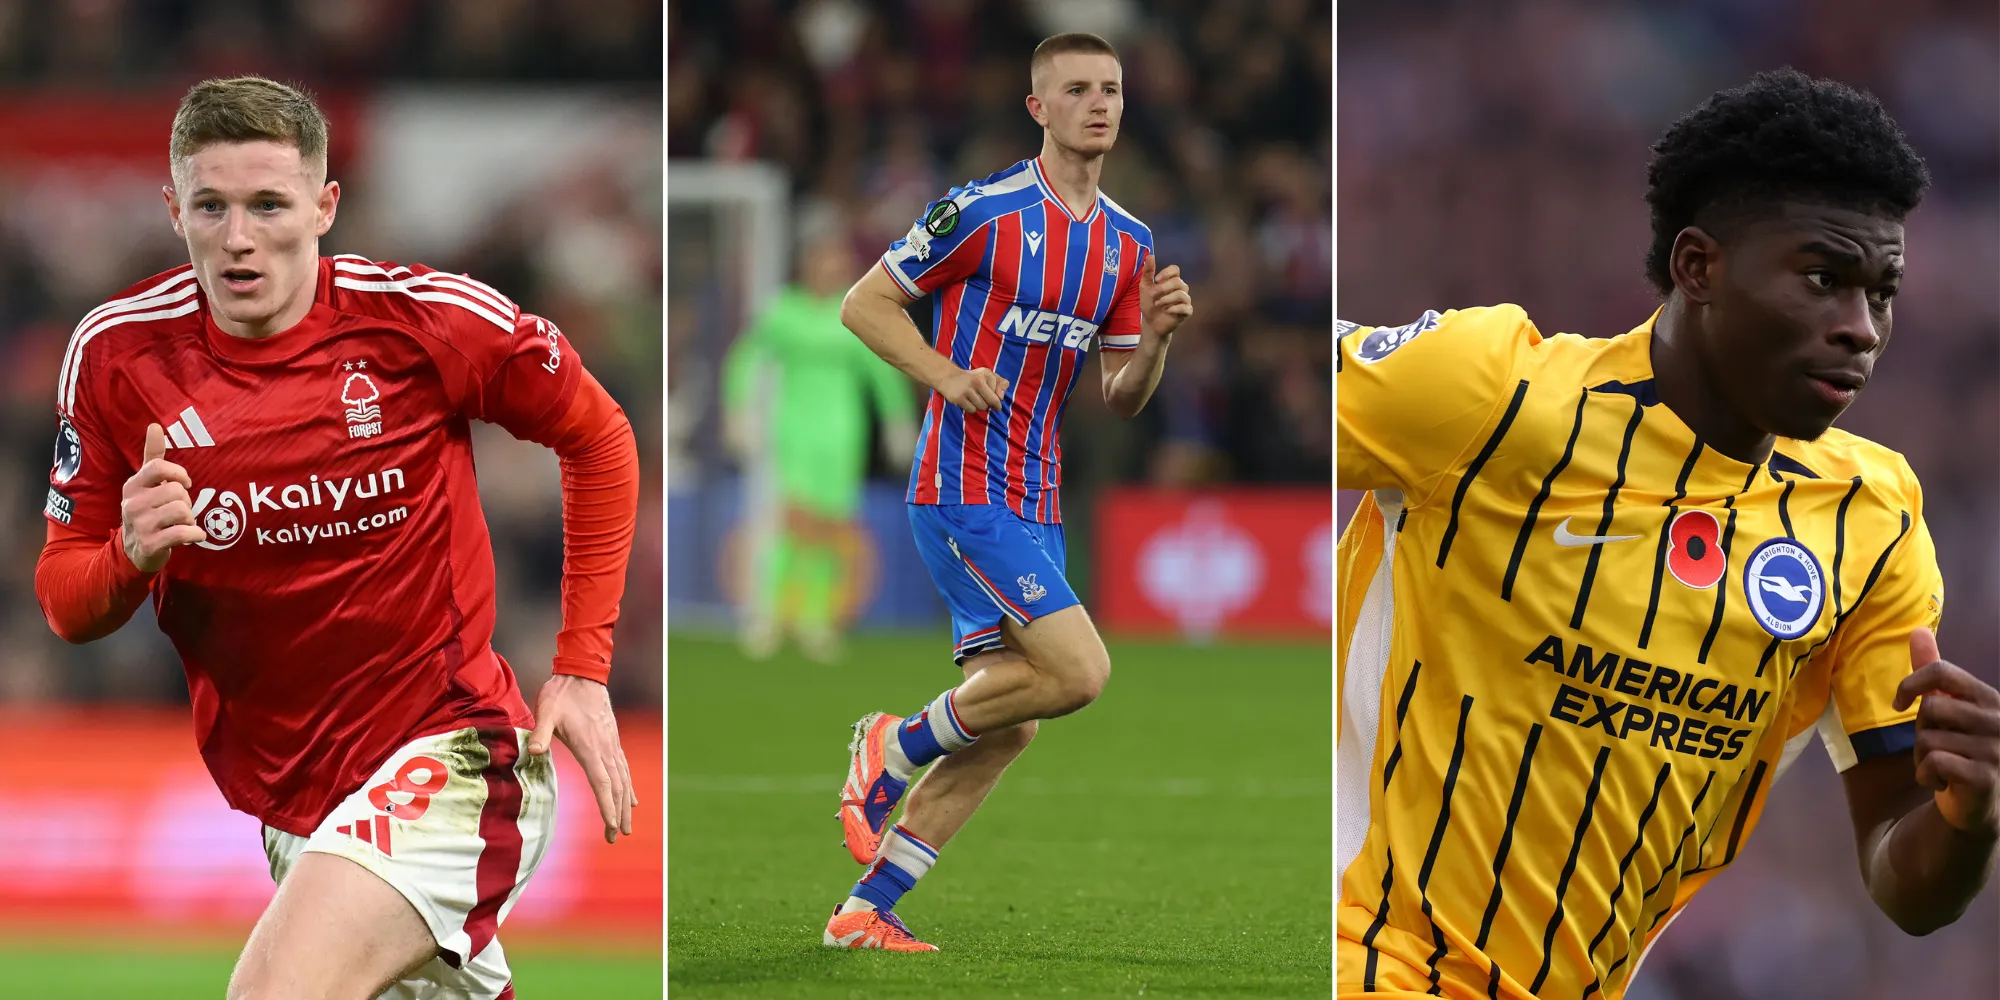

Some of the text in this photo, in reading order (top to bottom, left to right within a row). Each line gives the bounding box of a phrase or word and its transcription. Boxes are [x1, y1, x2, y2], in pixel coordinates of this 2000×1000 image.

[1760, 546, 1818, 581] BRIGHTON & HOVE
[1765, 616, 1792, 631] ALBION
[1524, 634, 1771, 723] AMERICAN
[1550, 683, 1752, 760] EXPRESS
[368, 756, 448, 820] 8
